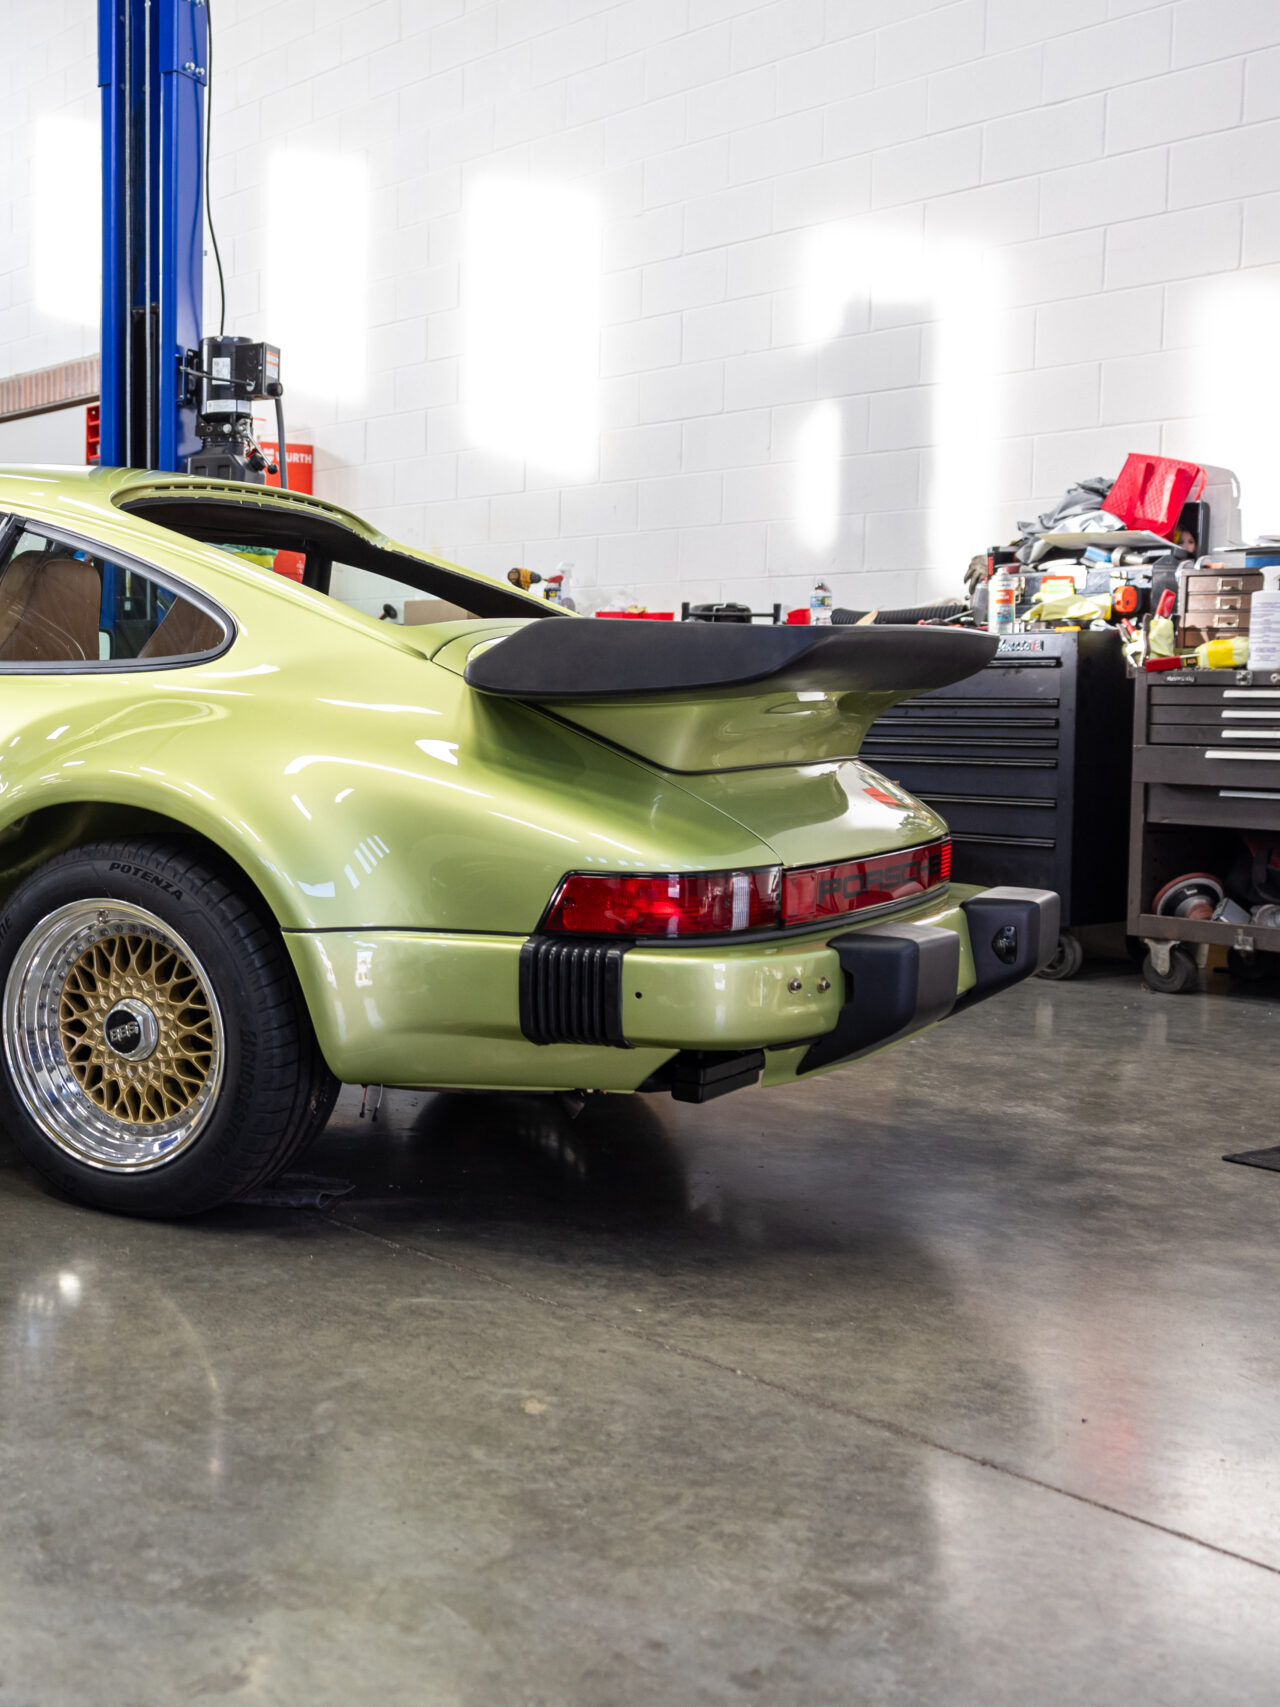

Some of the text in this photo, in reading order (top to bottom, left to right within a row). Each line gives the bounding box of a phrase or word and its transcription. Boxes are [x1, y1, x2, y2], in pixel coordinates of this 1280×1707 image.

[109, 862, 184, 900] POTENZA
[818, 853, 942, 904] PORSCHE
[109, 1020, 140, 1042] BBS
